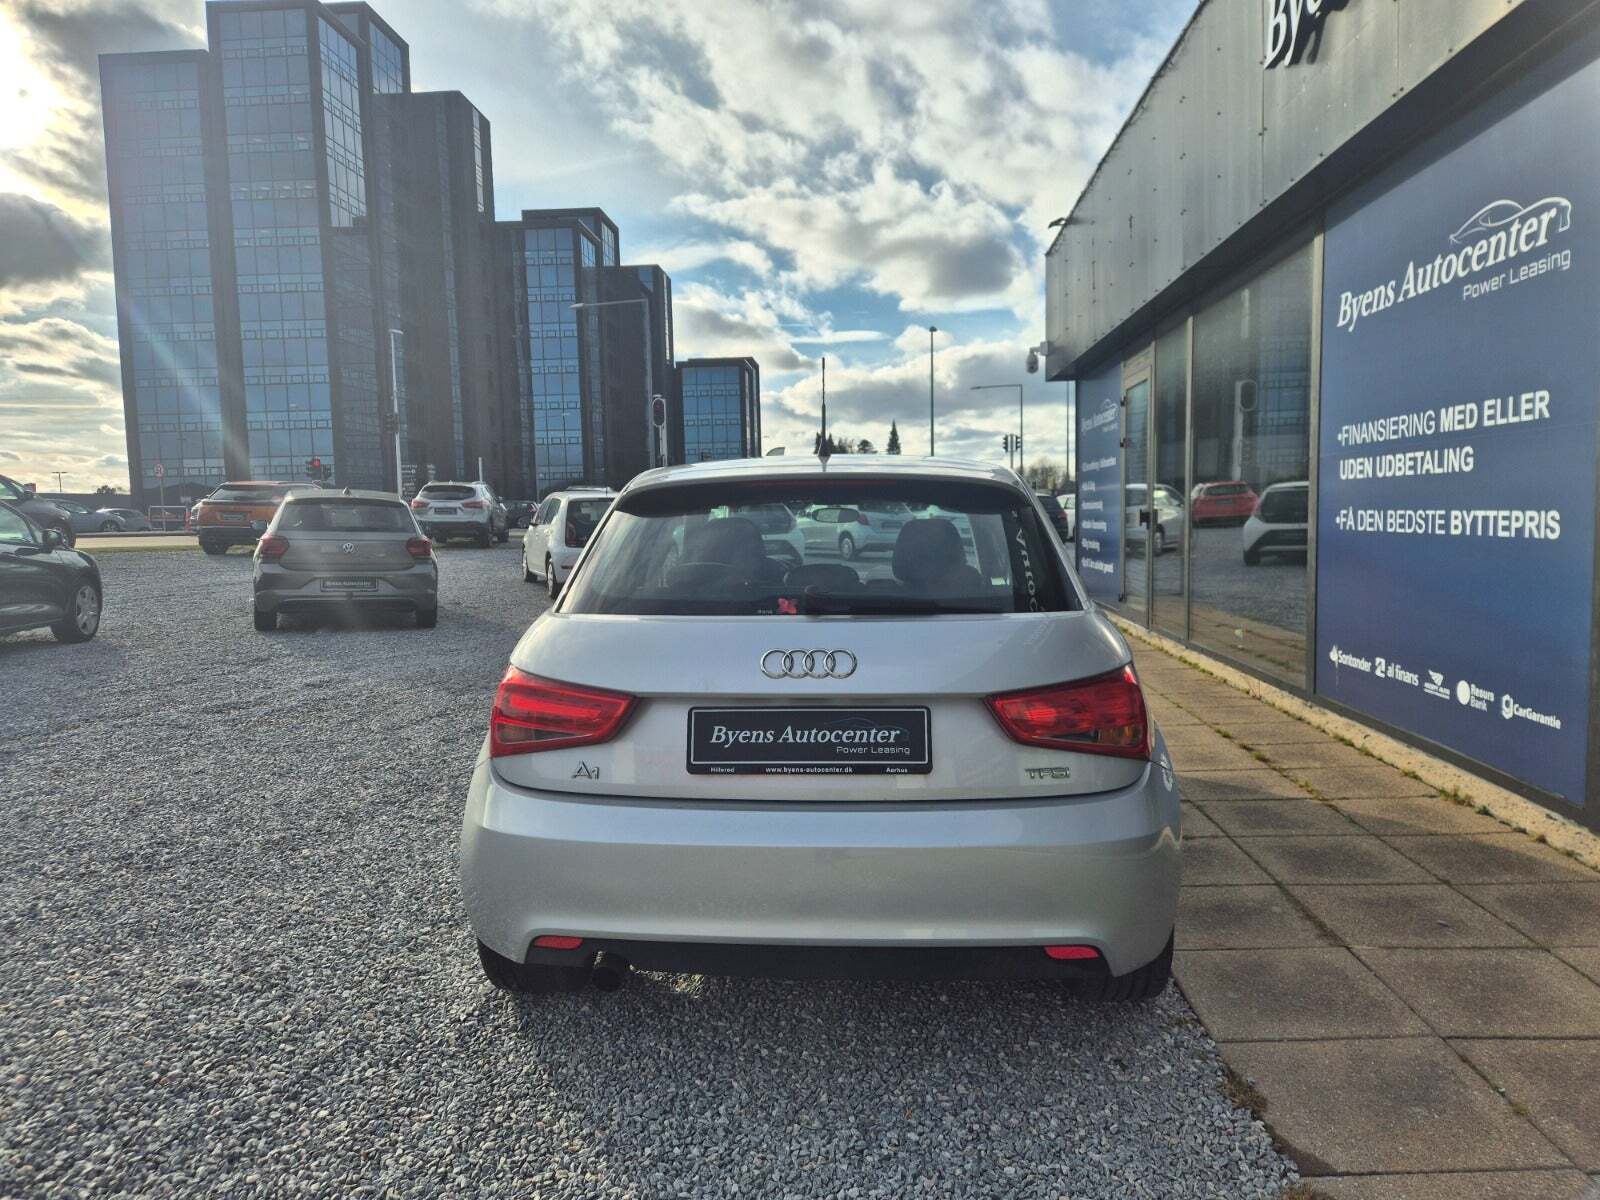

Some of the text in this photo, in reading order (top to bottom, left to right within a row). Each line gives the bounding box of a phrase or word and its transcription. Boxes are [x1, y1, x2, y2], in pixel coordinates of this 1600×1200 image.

[1336, 207, 1557, 332] Byens Autocenter
[1462, 249, 1571, 300] Power Leasing
[1439, 402, 1478, 433] MED
[1482, 390, 1550, 427] ELLER
[1339, 446, 1474, 480] UDEN UDBETALING
[1357, 509, 1384, 532] DEN
[1386, 510, 1446, 535] BEDSTE
[1450, 510, 1561, 540] BYTTEPRIS
[710, 725, 901, 748] Byens Autocenter
[836, 746, 911, 756] Power Leasing
[571, 760, 600, 780] A1
[765, 766, 853, 775] www.byens-autocenter.dk
[1024, 766, 1070, 779] TFSI
